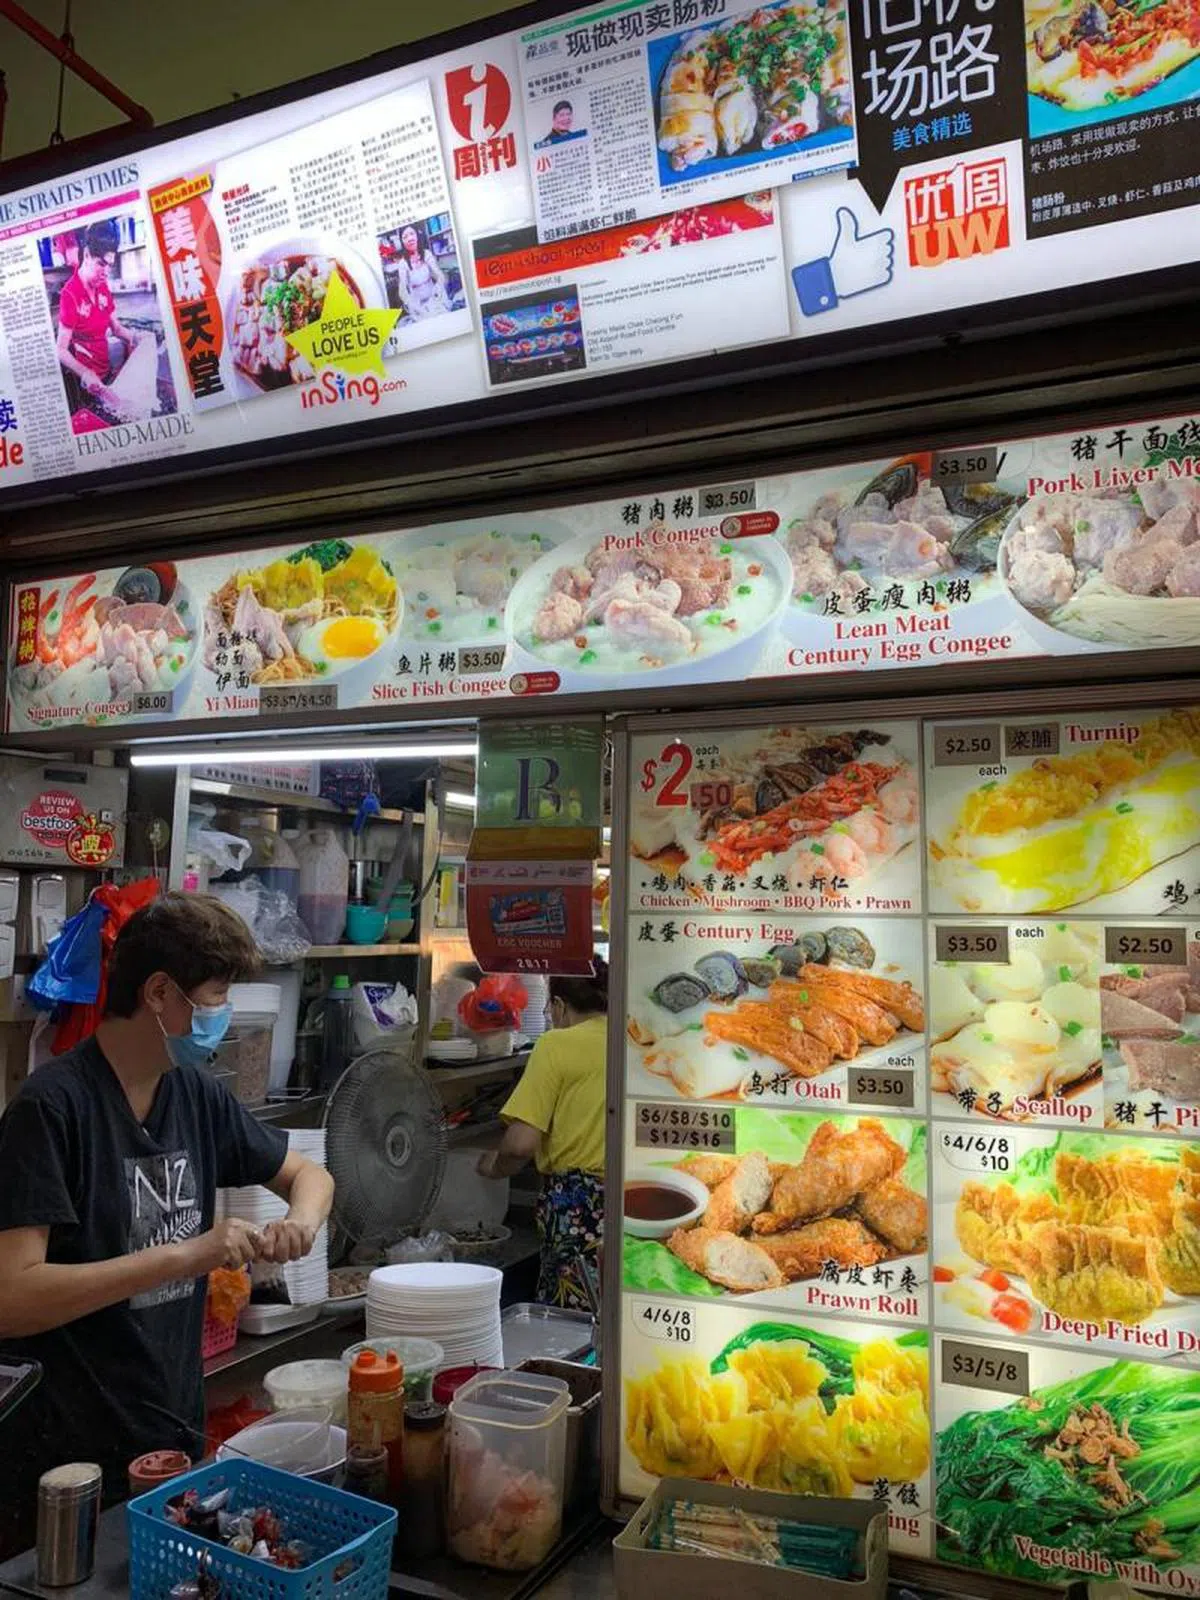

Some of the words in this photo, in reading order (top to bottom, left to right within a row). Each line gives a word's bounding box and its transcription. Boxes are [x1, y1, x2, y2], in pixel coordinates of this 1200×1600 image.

[566, 0, 727, 58] 现做现卖肠粉
[862, 24, 999, 120] 场路
[892, 111, 973, 151] 美食精选
[453, 133, 516, 180] 周刊
[18, 182, 84, 217] STRAITS
[84, 162, 140, 196] TIMES
[913, 210, 1004, 266] UW
[160, 205, 225, 400] 美味天堂
[321, 313, 365, 335] PEOPLE
[312, 333, 354, 358] LOVE
[357, 327, 380, 348] US
[301, 371, 407, 409] inSing.com
[76, 413, 195, 456] HAND-MADE
[1070, 419, 1200, 461] 猪干面线
[1028, 473, 1084, 497] Pork
[1093, 465, 1158, 489] Liver
[622, 495, 693, 526] 猪肉粥
[604, 532, 645, 551] Pork
[652, 524, 719, 548] Congee
[822, 578, 972, 617] 皮蛋瘦肉粥
[834, 624, 887, 641] Lean
[895, 613, 951, 634] Meat
[787, 642, 873, 670] Century
[880, 638, 922, 661] Egg
[927, 633, 1012, 658] Congee
[396, 652, 457, 677] 鱼片粥
[371, 684, 409, 701] Slice
[412, 679, 444, 697] Fish
[450, 677, 508, 697] Congee
[27, 705, 82, 724] Signature
[205, 698, 222, 712] Yi
[224, 695, 258, 712] Mian
[946, 738, 991, 754] $2.50
[1065, 723, 1140, 744] Turnip
[979, 766, 1008, 777] each
[39, 795, 77, 806] REVIEW
[640, 896, 690, 908] Chicken
[703, 896, 771, 909] Mushroom
[783, 896, 816, 909] BBQ
[820, 895, 852, 909] Pork
[866, 896, 912, 909] Prawn
[1162, 879, 1200, 905] 鸡
[638, 921, 679, 943] 皮蛋
[683, 922, 754, 942] Century
[760, 923, 794, 943] Egg
[948, 936, 998, 953] $3.50
[1015, 927, 1045, 938] each
[1118, 936, 1174, 955] $2.50
[516, 958, 549, 969] 2017
[886, 1056, 915, 1067] each
[795, 1079, 842, 1100] Otah
[856, 1078, 904, 1096] $3.50
[640, 1108, 732, 1129] $6/$8/$10
[1013, 1095, 1093, 1123] Scallop
[1113, 1100, 1168, 1126] 猪干
[650, 1129, 721, 1148] $12/$16
[944, 1135, 1009, 1154] $4/6/8
[980, 1155, 1010, 1172] $10
[819, 1258, 920, 1294] 腐皮虾枣
[806, 1286, 872, 1311] Prawn
[878, 1295, 920, 1317] Roll
[642, 1306, 692, 1326] 4/6/8
[666, 1326, 692, 1342] $10
[1043, 1311, 1100, 1342] Deep
[1106, 1320, 1169, 1348] Fried
[952, 1353, 1018, 1381] $3/5/8
[1013, 1534, 1112, 1576] Vegetable
[1115, 1560, 1162, 1587] with
